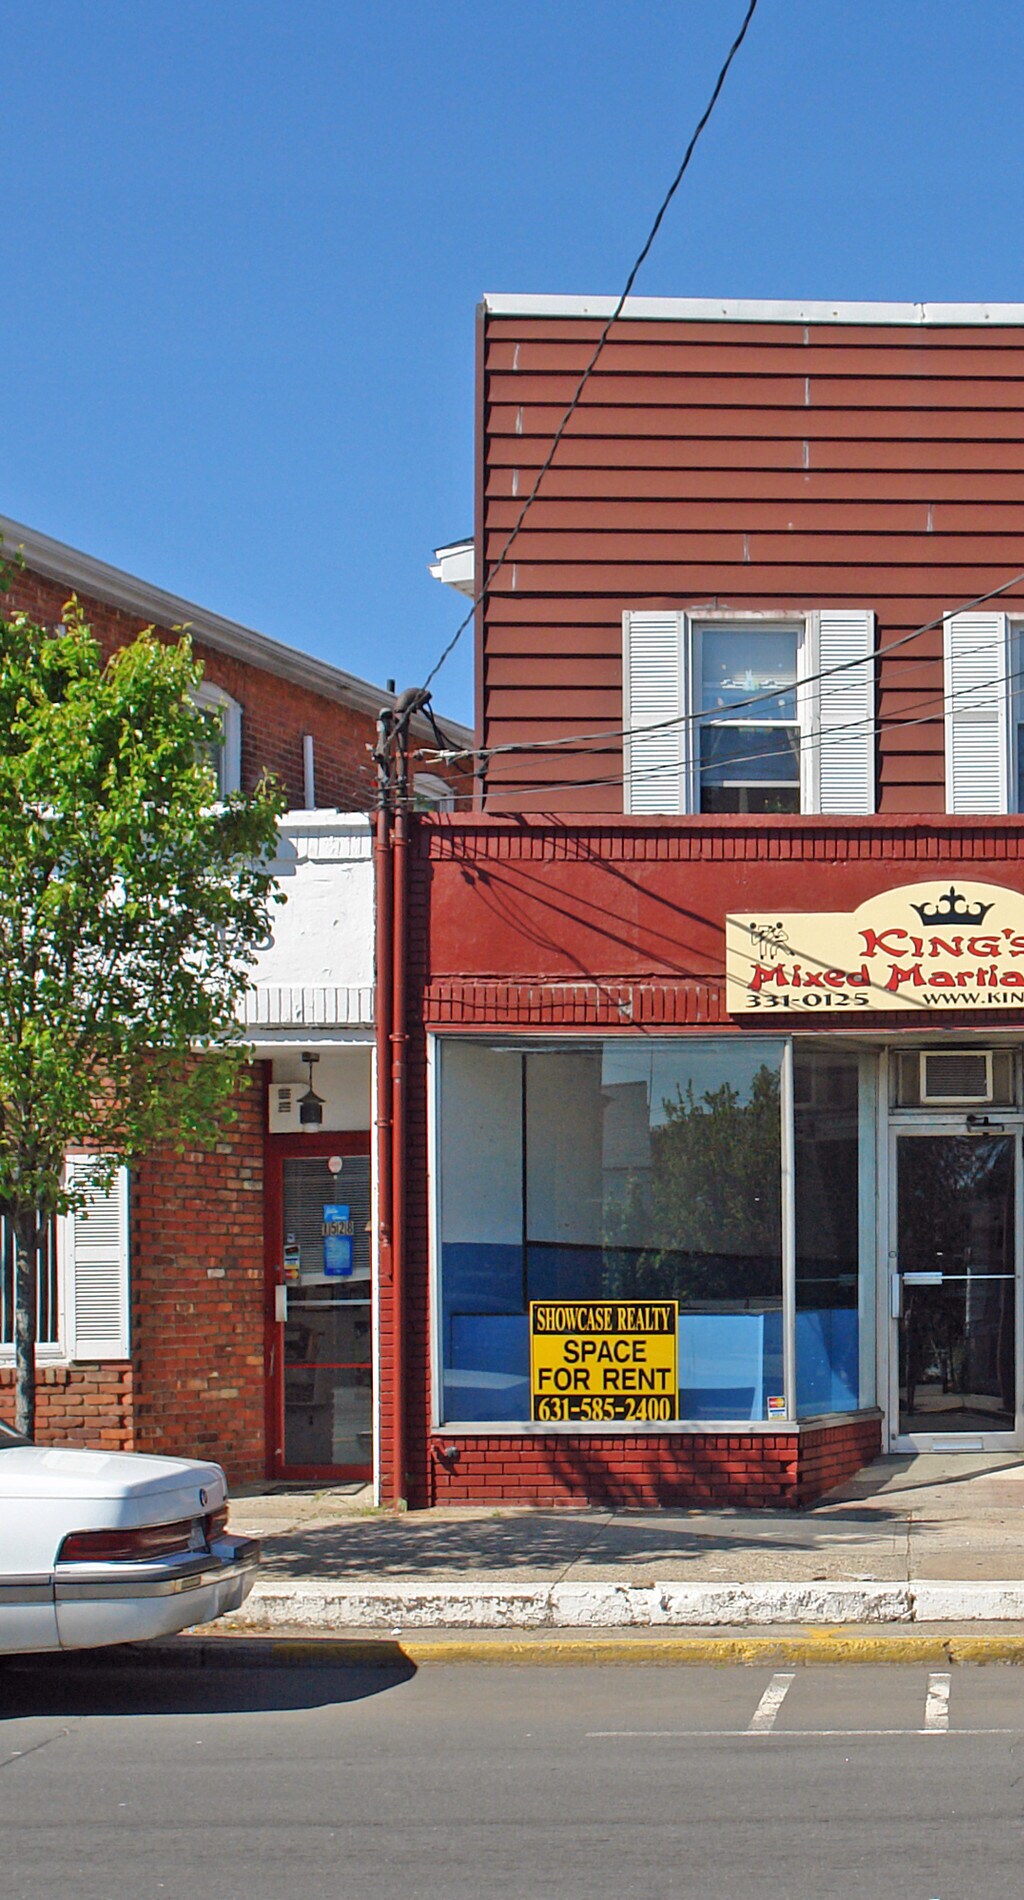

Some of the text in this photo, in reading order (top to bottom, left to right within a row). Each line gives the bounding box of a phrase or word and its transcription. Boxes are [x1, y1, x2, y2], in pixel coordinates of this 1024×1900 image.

[746, 963, 872, 992] Mixed
[745, 992, 870, 1008] 331-0125
[536, 1306, 671, 1331] SHOWCASE REALTY
[563, 1339, 647, 1363] SPACE
[538, 1367, 671, 1390] FOR RENT
[538, 1397, 671, 1421] 631-585-2400
